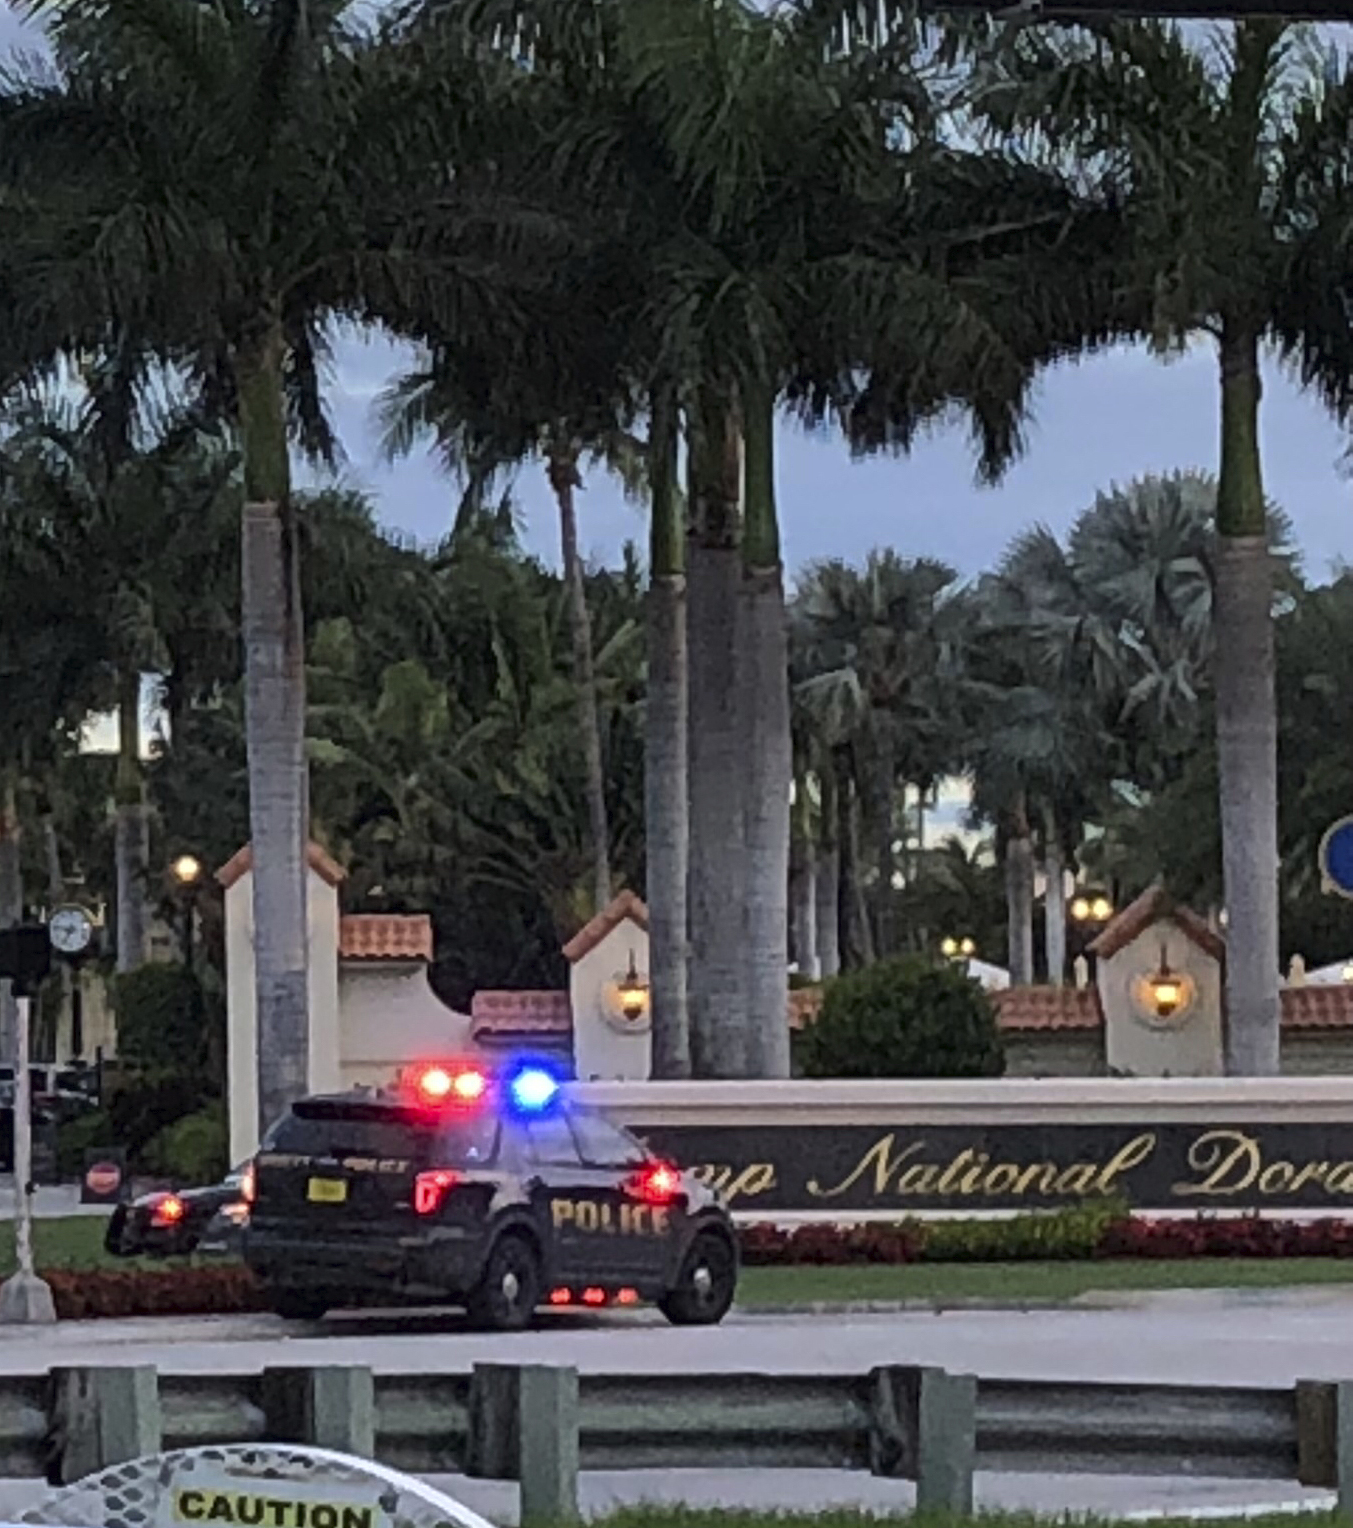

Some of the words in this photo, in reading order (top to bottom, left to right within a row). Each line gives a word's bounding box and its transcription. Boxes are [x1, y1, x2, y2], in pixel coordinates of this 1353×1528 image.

[805, 1132, 1157, 1197] National
[550, 1198, 671, 1236] POLICE
[178, 1490, 372, 1528] CAUTION
